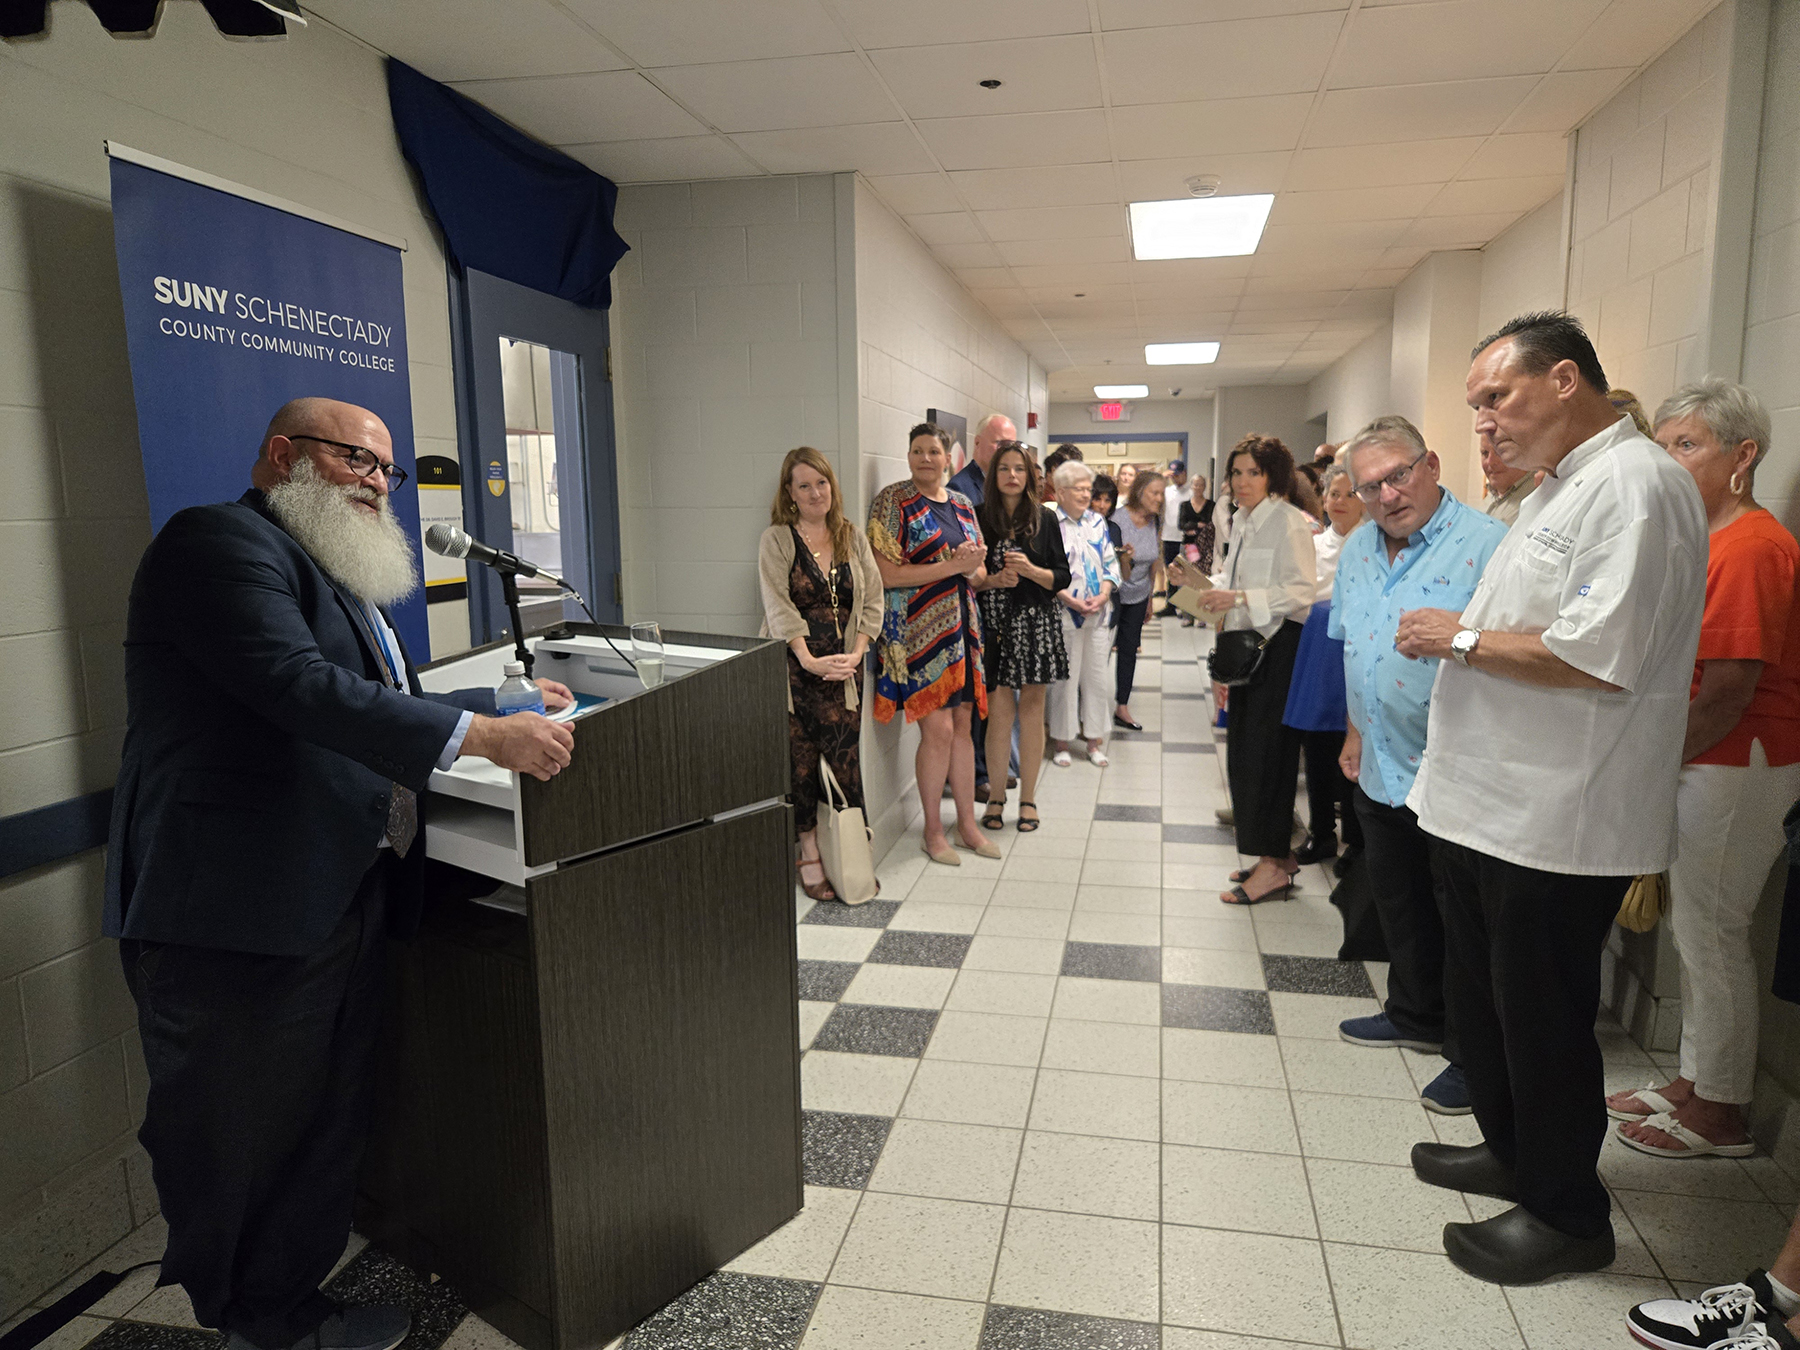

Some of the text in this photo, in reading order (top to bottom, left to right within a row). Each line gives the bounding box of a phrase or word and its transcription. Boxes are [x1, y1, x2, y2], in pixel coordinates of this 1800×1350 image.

[153, 276, 392, 348] SUNY SCHENECTADY
[159, 317, 395, 373] COUNTY COMMUNITY COLLEGE
[1103, 405, 1120, 419] EXIT
[433, 467, 443, 475] 101
